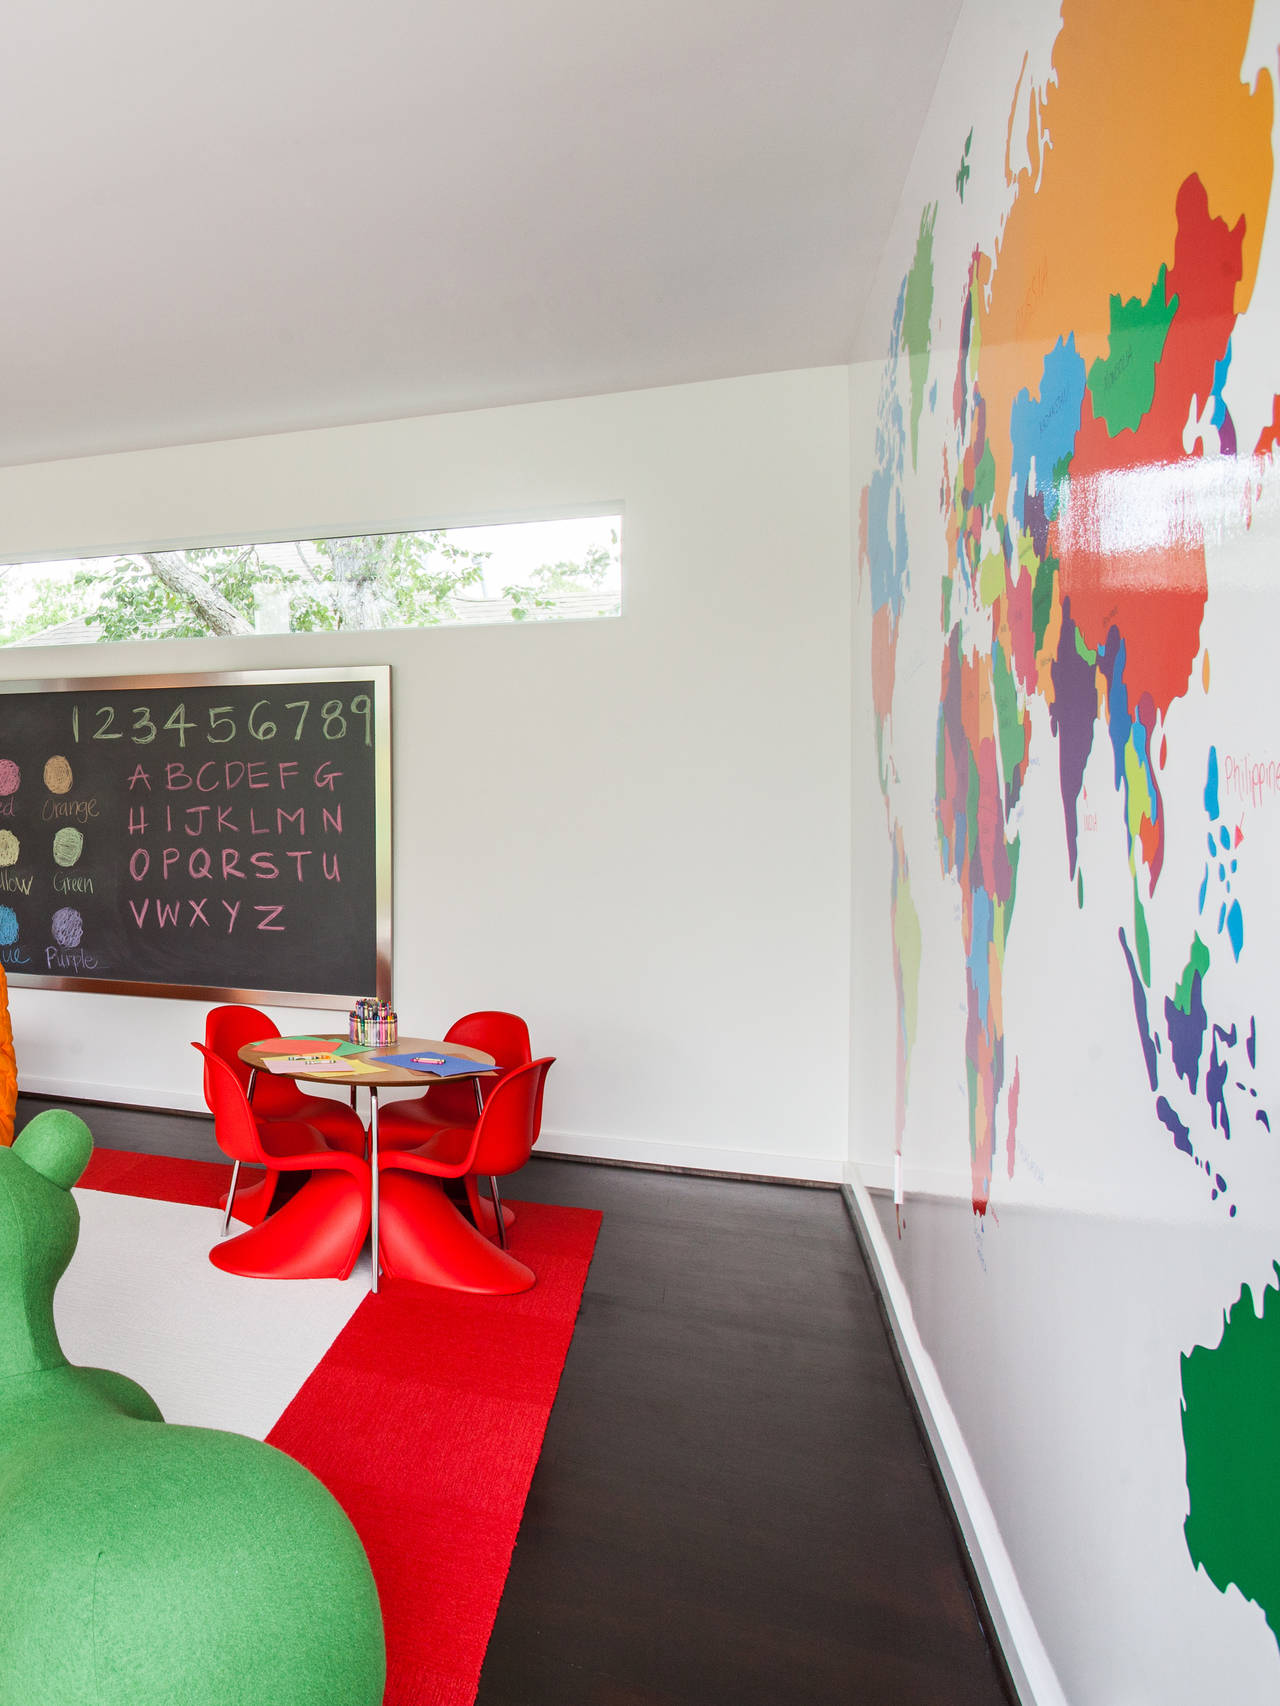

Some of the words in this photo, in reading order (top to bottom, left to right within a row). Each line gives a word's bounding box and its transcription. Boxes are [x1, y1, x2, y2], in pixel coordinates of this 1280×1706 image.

[42, 798, 100, 824] Orange
[53, 871, 94, 895] Green
[45, 945, 99, 974] Purple
